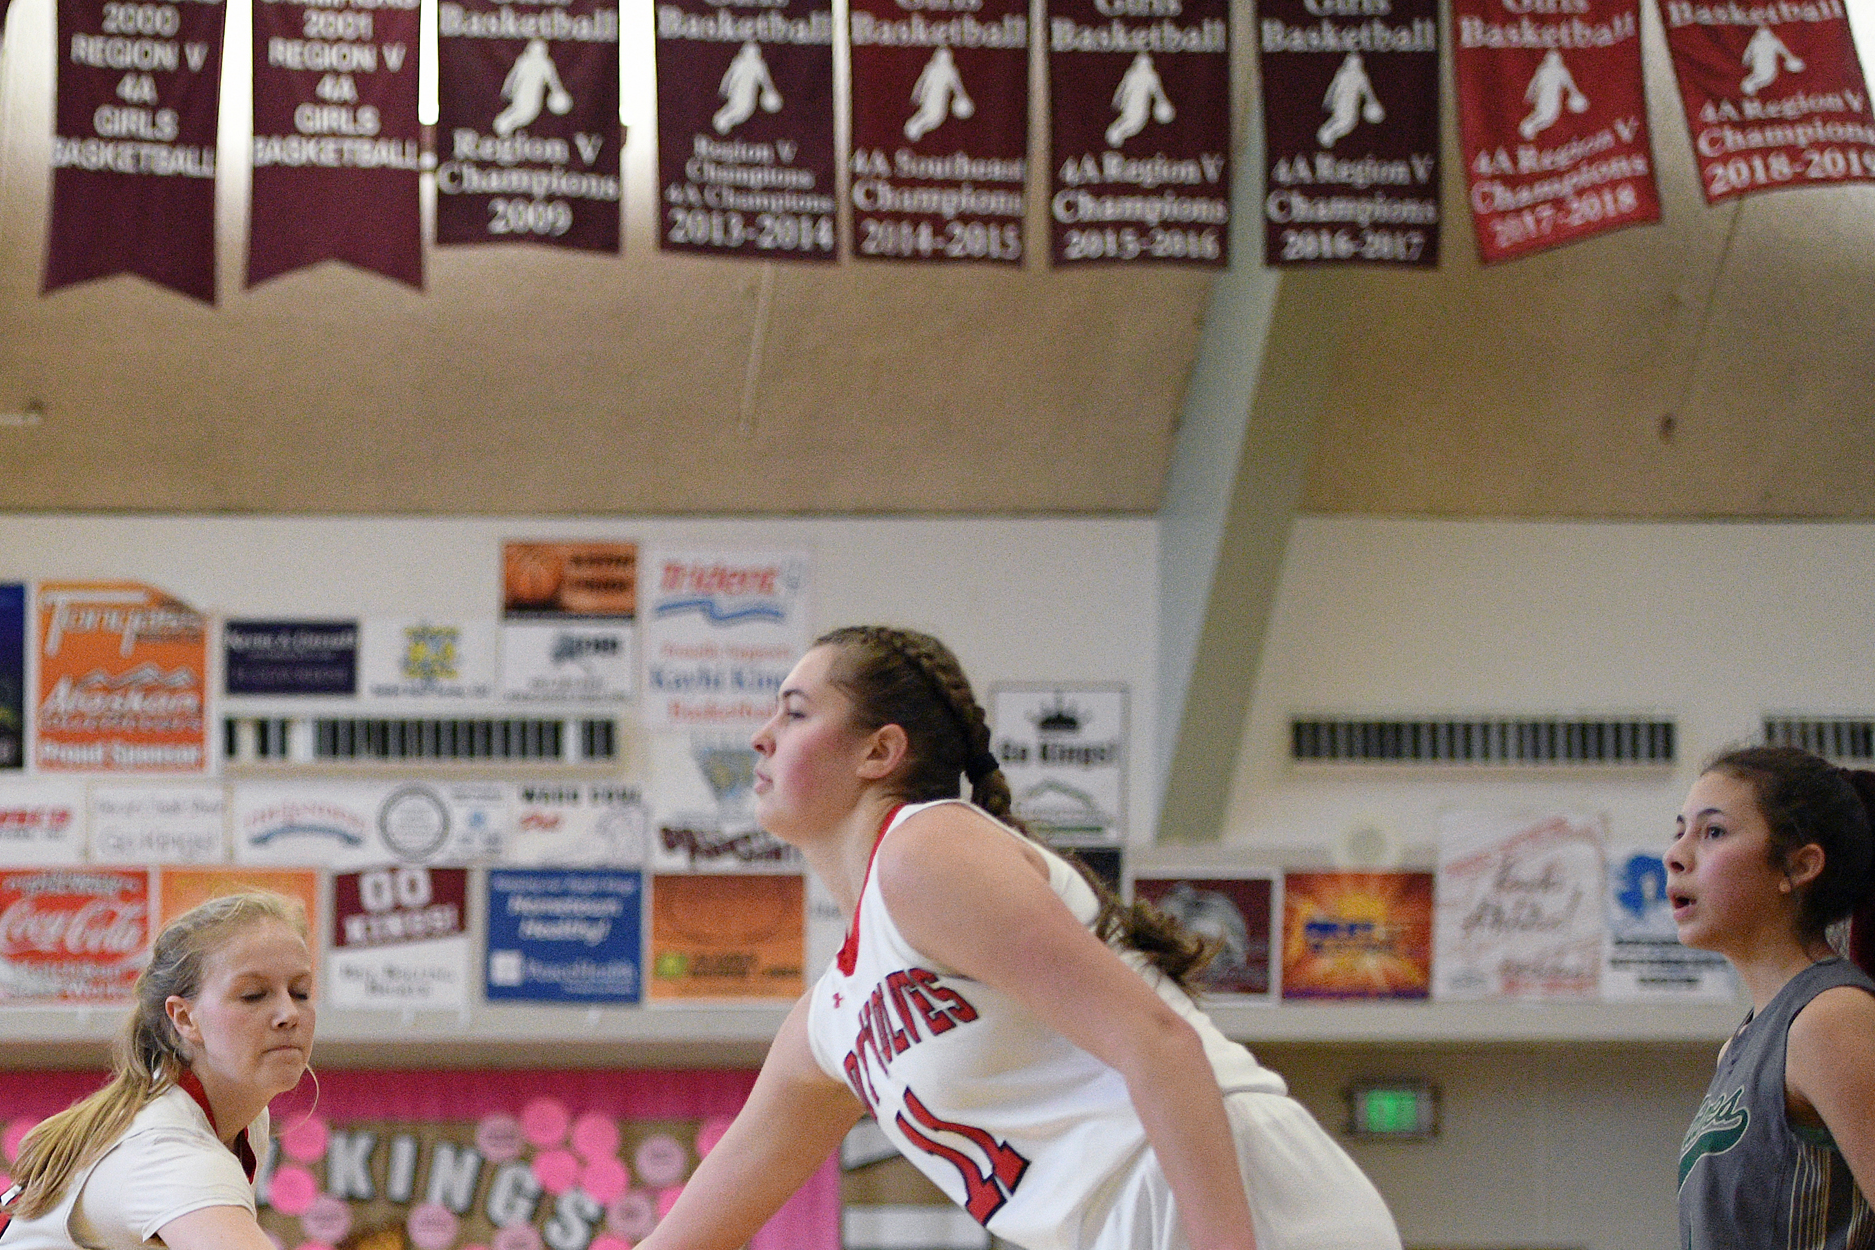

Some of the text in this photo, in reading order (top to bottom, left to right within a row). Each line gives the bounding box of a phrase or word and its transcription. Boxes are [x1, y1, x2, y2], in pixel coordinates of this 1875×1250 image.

[102, 3, 180, 36] 2000
[303, 7, 374, 39] 2001
[440, 5, 618, 43] Basketball
[659, 5, 833, 45] Basketball
[851, 11, 1027, 48] Basketball
[1051, 16, 1225, 52] Basketball
[1260, 16, 1436, 53] Basketball
[1459, 12, 1636, 50] Basketball
[70, 34, 208, 72] REGION V
[267, 38, 407, 72] REGION V
[116, 72, 158, 104] 4A
[315, 72, 358, 103] 4A
[93, 105, 179, 141] GIRLS
[294, 104, 380, 136] GIRLS
[1699, 99, 1742, 122] 4A
[1744, 91, 1832, 121] Region
[453, 130, 603, 167] Region V
[851, 148, 891, 178] 4A
[1472, 117, 1641, 177] 4A Region V
[437, 162, 619, 201] Champions
[1059, 152, 1224, 188] 4A Region V
[1272, 154, 1435, 187] 4A Region V
[1470, 153, 1648, 215] Champions
[852, 179, 1024, 218] Champions
[1052, 189, 1229, 226] Champions
[1266, 189, 1437, 226] Champions
[1490, 184, 1637, 248] 2017-2018
[487, 200, 573, 236] 2009
[860, 218, 1021, 259] 2014-2015
[1063, 227, 1220, 260] 2015-2016
[1281, 228, 1424, 262] 2016-2017
[895, 1085, 1031, 1226] 11
